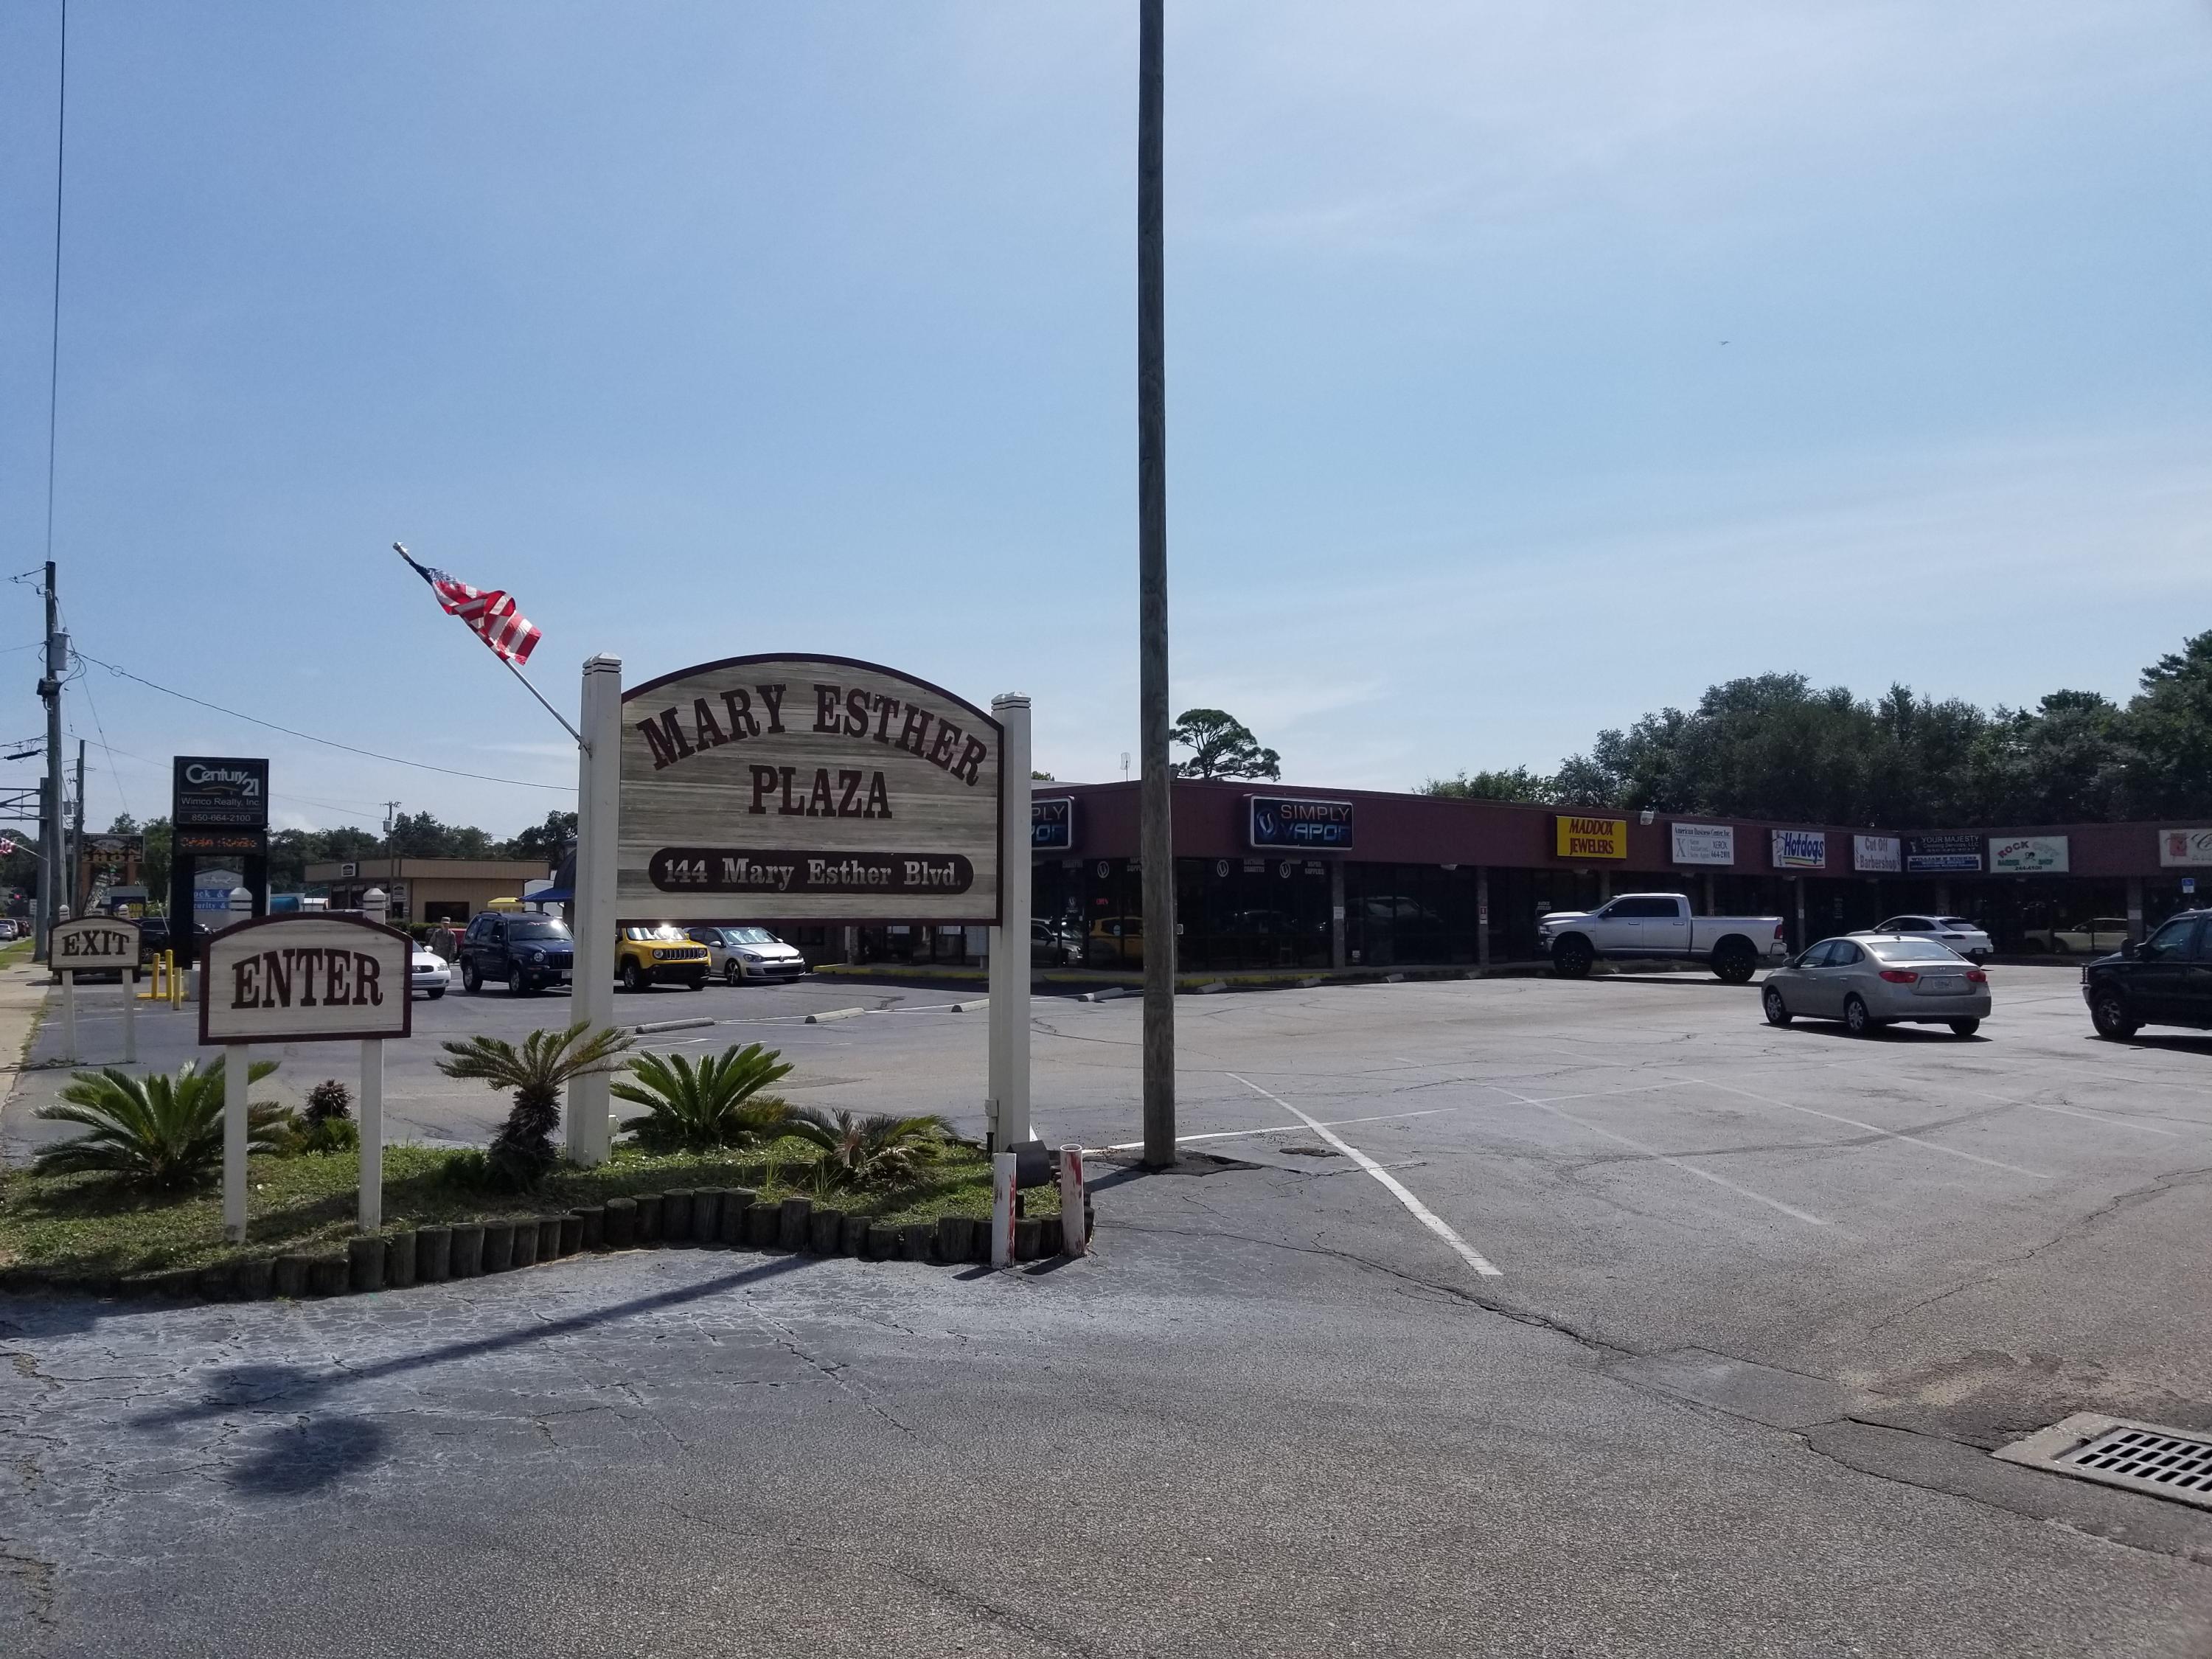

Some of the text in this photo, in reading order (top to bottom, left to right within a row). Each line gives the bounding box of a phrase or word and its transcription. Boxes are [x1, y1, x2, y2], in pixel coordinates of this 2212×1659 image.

[636, 684, 989, 787] MARY ESTHER
[186, 764, 259, 796] Century 21
[181, 796, 212, 806] Wimco
[748, 765, 893, 819] PLAZA
[192, 813, 251, 822] 850-664-2100
[1032, 805, 1065, 821] PLY
[1281, 804, 1349, 822] SIMPLY
[1569, 818, 1615, 835] MADDOX
[1569, 837, 1614, 855] JEWELERS
[1784, 832, 1823, 864] Hotdogs
[1865, 837, 1876, 852] Cut
[1997, 841, 2029, 859] ROCK
[1860, 855, 1897, 871] Barbershop
[664, 858, 961, 891] 144 Mary Esther Blvd.
[194, 889, 210, 898] ock
[61, 929, 130, 956] EXIT
[231, 947, 383, 1009] ENTER
